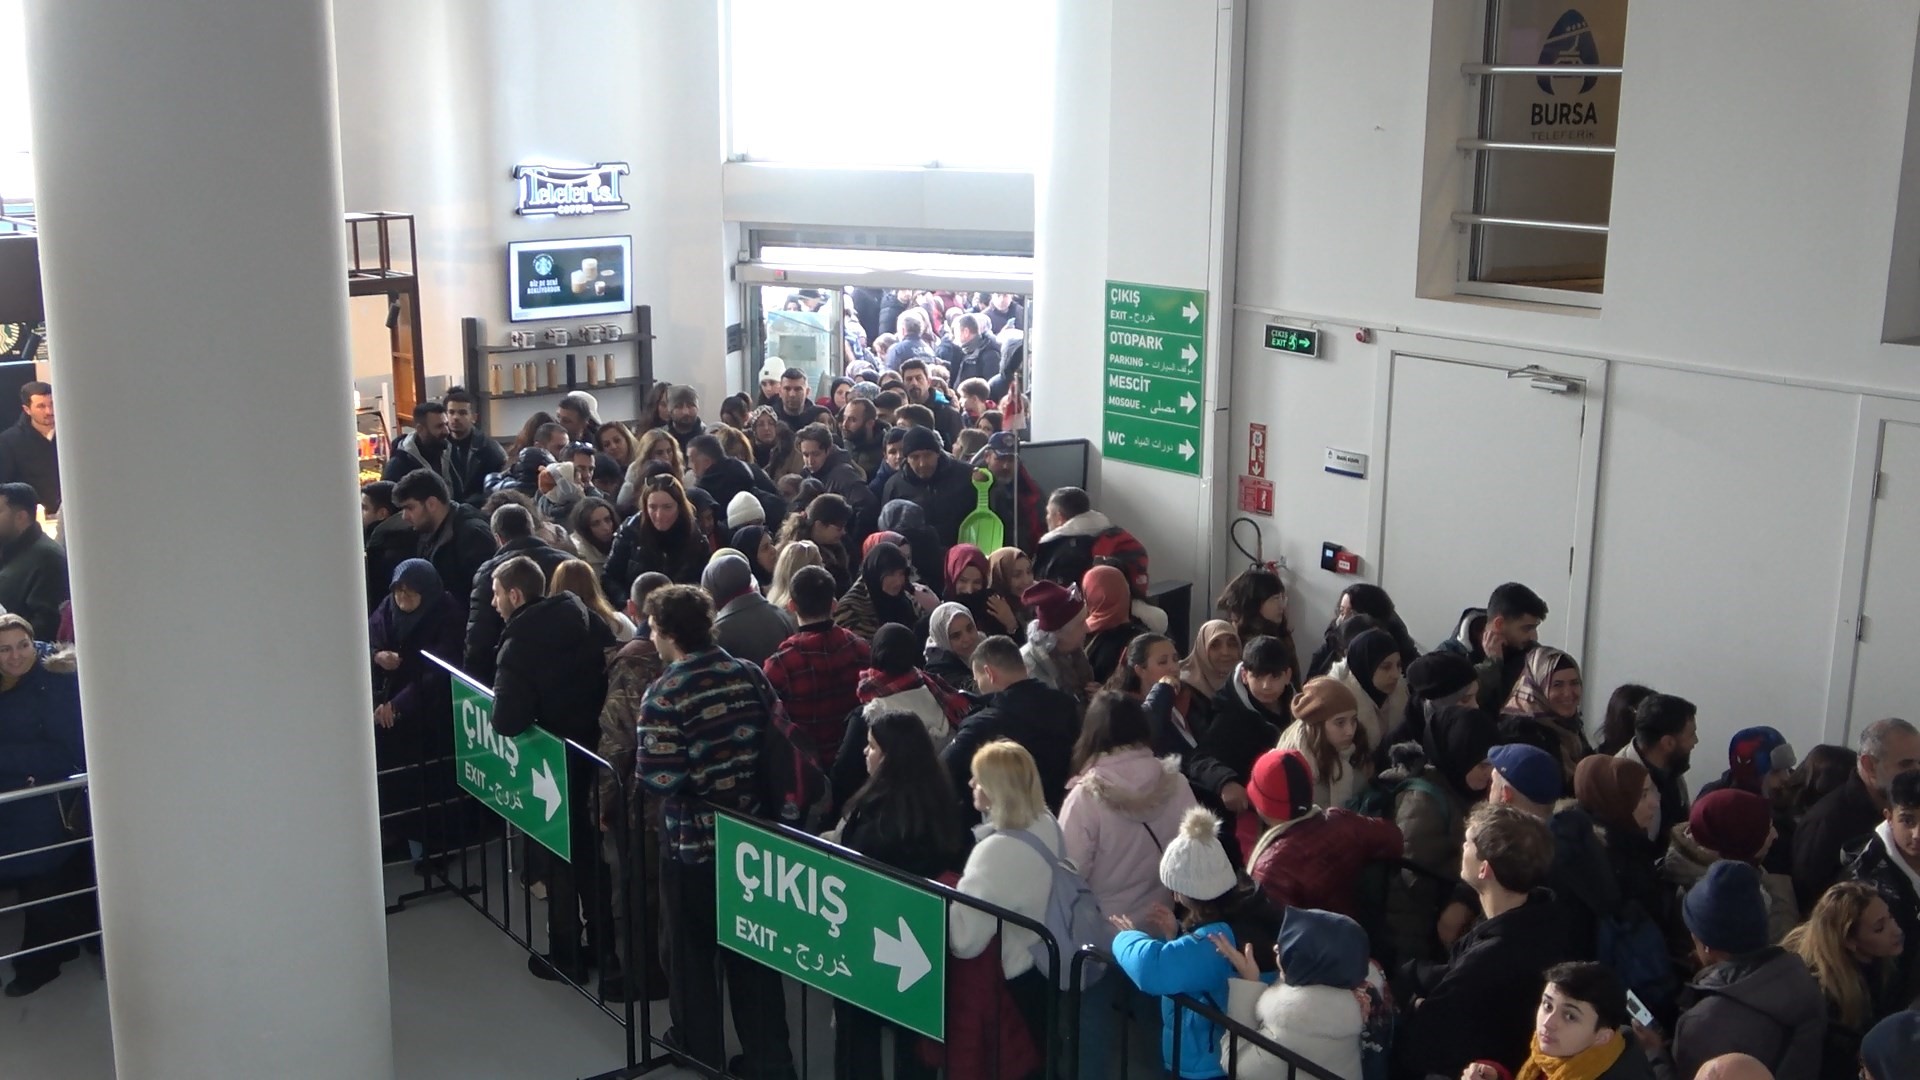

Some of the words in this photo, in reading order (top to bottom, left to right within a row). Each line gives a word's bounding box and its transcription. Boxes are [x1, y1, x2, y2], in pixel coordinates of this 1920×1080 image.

[1531, 102, 1598, 126] BURSA
[1111, 288, 1140, 308] ÇIKIŞ
[1110, 310, 1127, 320] EXIT
[1134, 312, 1155, 323] خروج
[1110, 331, 1163, 351] OTOPARK
[1272, 338, 1287, 347] EXIT
[1109, 353, 1144, 367] PARKING
[1109, 374, 1151, 392] MESCİT
[1108, 396, 1140, 409] MOSQUE
[1108, 431, 1125, 446] WC
[465, 761, 486, 790] EXIT
[495, 782, 523, 810] خروج
[736, 841, 848, 938] ÇIKIŞ
[736, 915, 778, 952] EXIT
[796, 943, 853, 977] خروج
